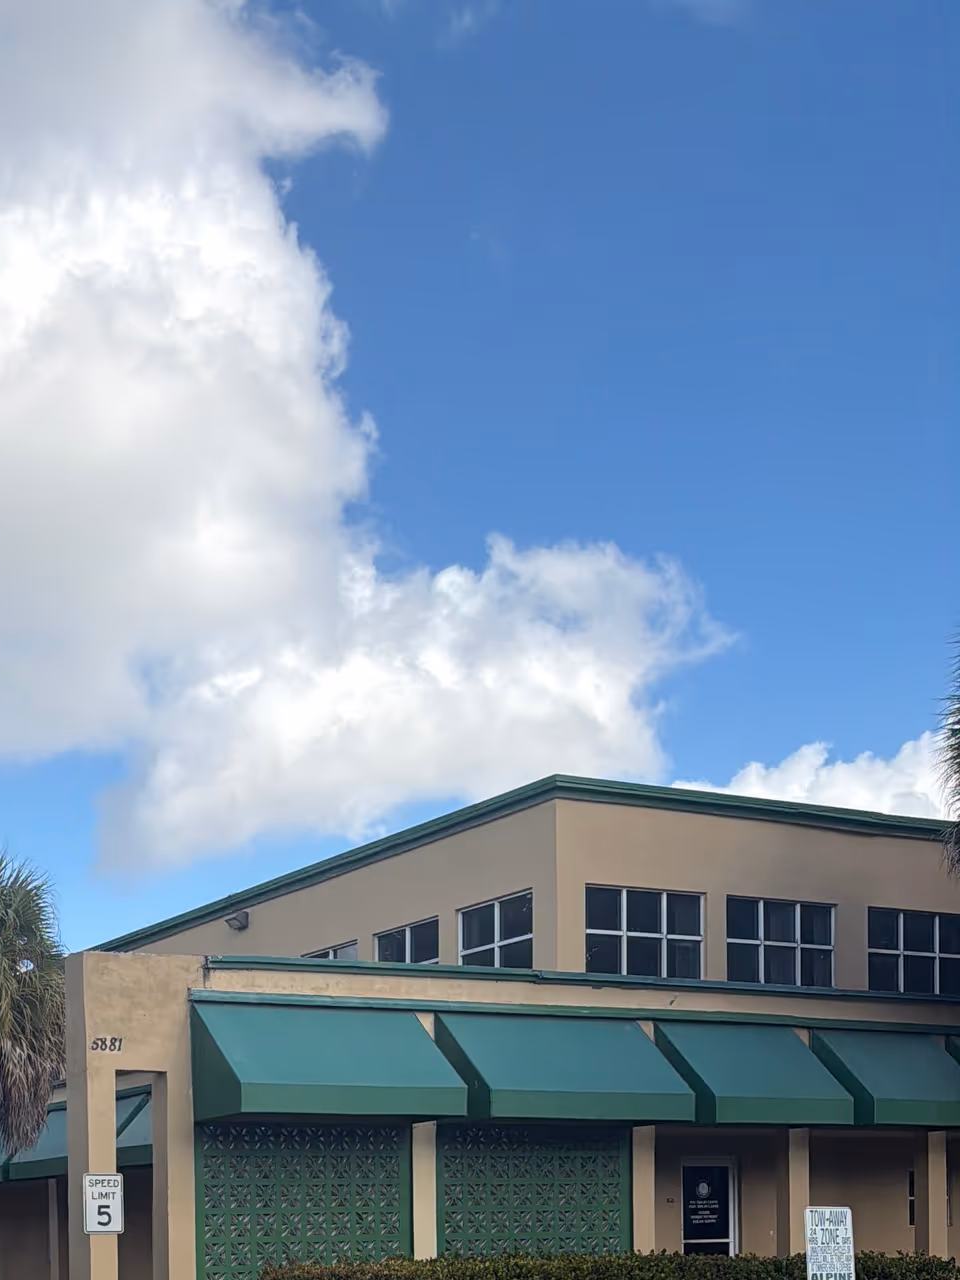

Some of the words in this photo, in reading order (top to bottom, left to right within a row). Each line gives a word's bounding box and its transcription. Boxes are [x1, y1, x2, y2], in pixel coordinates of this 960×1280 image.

[91, 1037, 123, 1051] 5881
[88, 1179, 120, 1188] SPEED
[91, 1191, 117, 1200] LIMIT
[97, 1205, 112, 1226] 5
[809, 1210, 848, 1227] TOW-AWAY
[820, 1228, 840, 1245] ZONE
